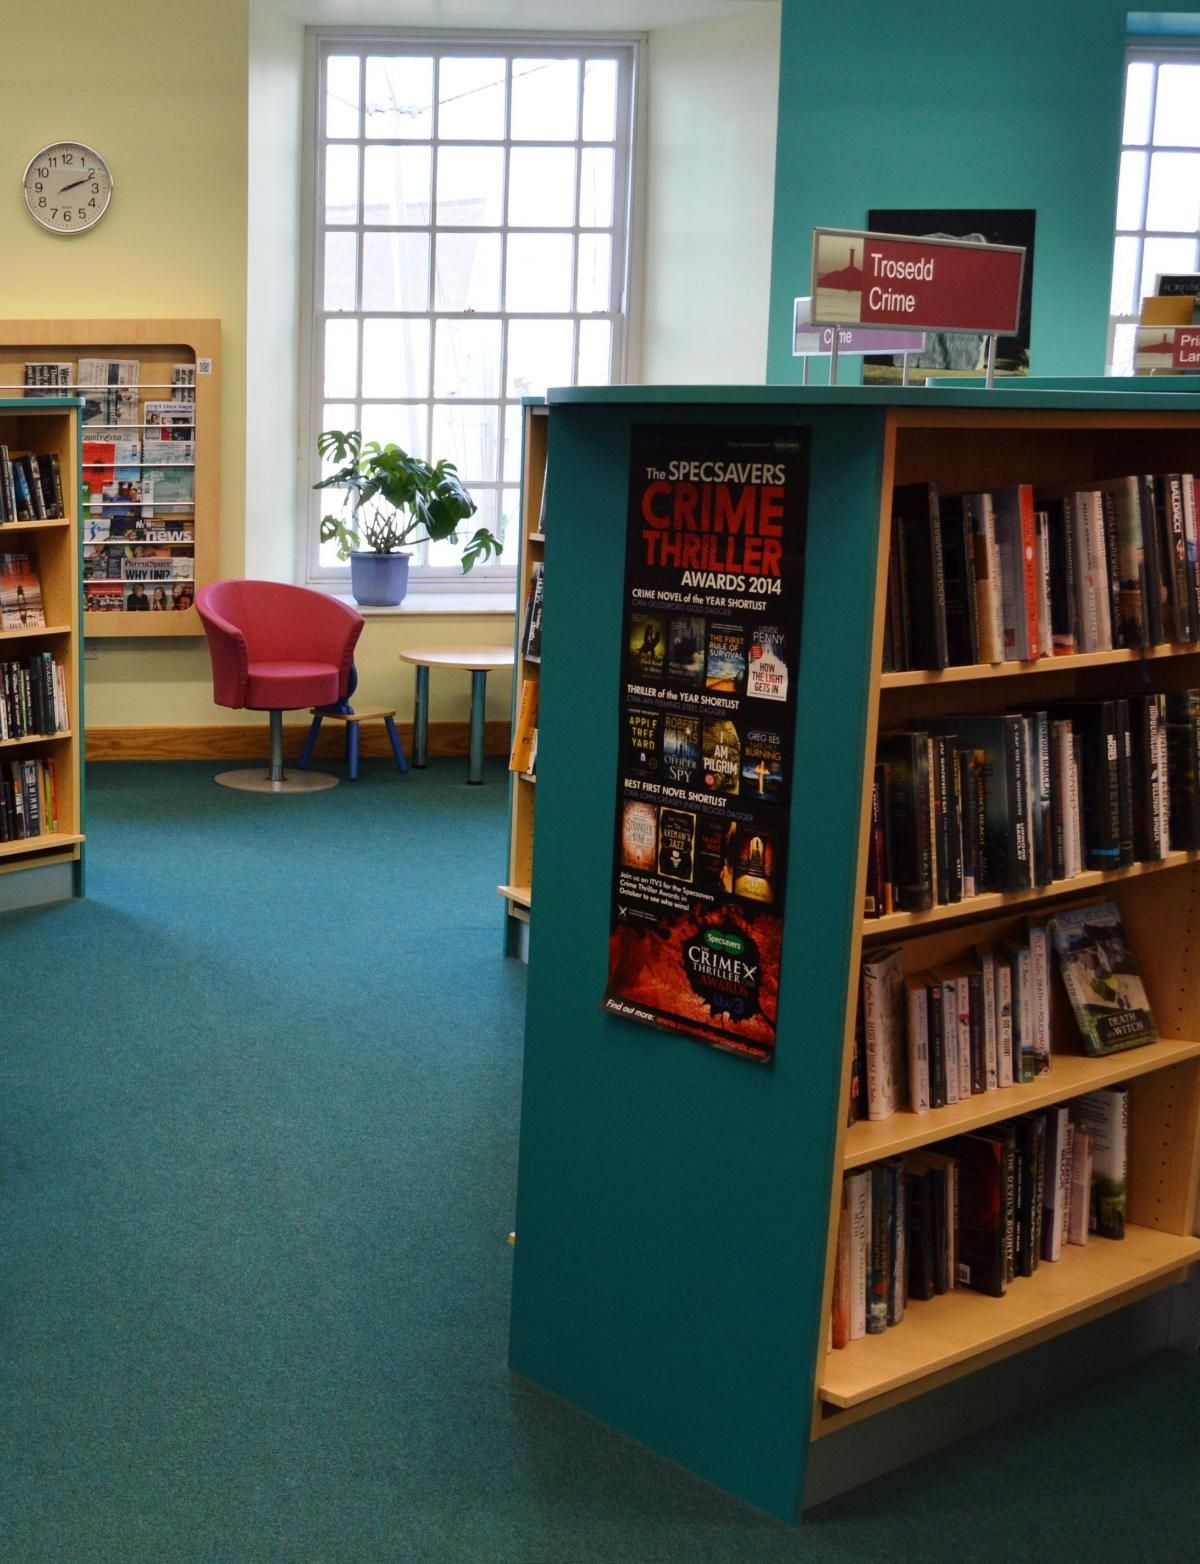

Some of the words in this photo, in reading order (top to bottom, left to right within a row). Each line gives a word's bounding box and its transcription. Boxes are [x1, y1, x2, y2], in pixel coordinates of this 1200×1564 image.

[48, 157, 57, 168] 11
[62, 154, 72, 164] 12
[81, 157, 85, 168] 1
[38, 167, 49, 178] 10
[88, 168, 96, 179] 2
[35, 182, 43, 193] 9
[91, 183, 99, 194] 3
[39, 196, 47, 208] 8
[88, 198, 96, 208] 4
[51, 208, 58, 219] 7
[63, 211, 71, 222] 6
[78, 208, 86, 219] 5
[871, 253, 934, 281] Trosedd
[869, 287, 915, 312] Crime
[646, 467, 666, 480] The
[668, 460, 786, 485] SPECSAVERS
[640, 480, 785, 537] CRIME
[1170, 480, 1182, 533] BALDACCI
[145, 529, 192, 542] news
[641, 529, 784, 577] THRILLER
[125, 570, 149, 580] WHY
[680, 571, 746, 592] AWARDS
[749, 577, 782, 595] 2014
[632, 588, 655, 600] CRIME
[657, 590, 682, 603] NOVEL
[683, 594, 692, 603] of
[692, 594, 704, 604] the
[705, 596, 726, 606] YEAR
[727, 599, 767, 611] SHORTLIST
[1089, 586, 1098, 640] VISIONS
[724, 635, 744, 644] FIRST
[753, 631, 785, 645] PENNY
[709, 642, 727, 651] RULE
[728, 643, 739, 651] OF
[709, 649, 744, 659] SURVIVAL
[760, 663, 775, 672] HOW
[753, 671, 766, 681] THE
[766, 673, 784, 683] LIGHT
[755, 682, 770, 693] GETS
[771, 684, 779, 694] IN
[627, 684, 657, 697] THRILLER
[658, 691, 666, 699] of
[666, 690, 678, 700] the
[680, 692, 700, 702] YEAR
[700, 694, 740, 710] SHORTLIST
[629, 715, 658, 728] APPLE
[665, 716, 700, 730] ROBERT
[632, 727, 654, 737] TREE
[719, 731, 724, 743] I
[747, 732, 767, 742] GREG
[632, 737, 655, 750] YARD
[940, 742, 945, 755] JO
[714, 744, 728, 759] AM
[745, 749, 782, 761] BURNING
[1016, 749, 1020, 761] ON
[664, 754, 697, 769] OFFICER
[703, 758, 738, 775] PILGRIM
[669, 766, 692, 783] SPY
[624, 778, 641, 788] BEST
[642, 782, 661, 792] FIRST
[662, 785, 687, 799] NOVEL
[688, 791, 727, 807] SHORTLIST
[940, 758, 948, 814] BANNISTER
[978, 814, 986, 845] REACH
[669, 838, 685, 850] JAZZ
[619, 880, 636, 890] Crime
[638, 884, 658, 895] Thriller
[659, 889, 681, 900] Awards
[681, 893, 688, 901] in
[620, 871, 631, 879] Join
[650, 878, 662, 886] ITV3
[663, 880, 671, 889] for
[672, 882, 682, 892] the
[683, 886, 715, 902] Specsavers
[619, 888, 642, 899] October
[661, 897, 673, 906] who
[674, 901, 690, 912] wins!
[706, 933, 742, 950] Specsavers
[688, 945, 741, 974] CRIME
[693, 961, 741, 984] THRILLER
[606, 999, 621, 1011] Find
[623, 1004, 635, 1015] out
[635, 1010, 656, 1022] more:
[1108, 1013, 1137, 1024] DEATH
[1113, 1022, 1144, 1035] WITCH
[1064, 1158, 1072, 1184] DEATH
[1006, 1220, 1014, 1260] BOUNTY
